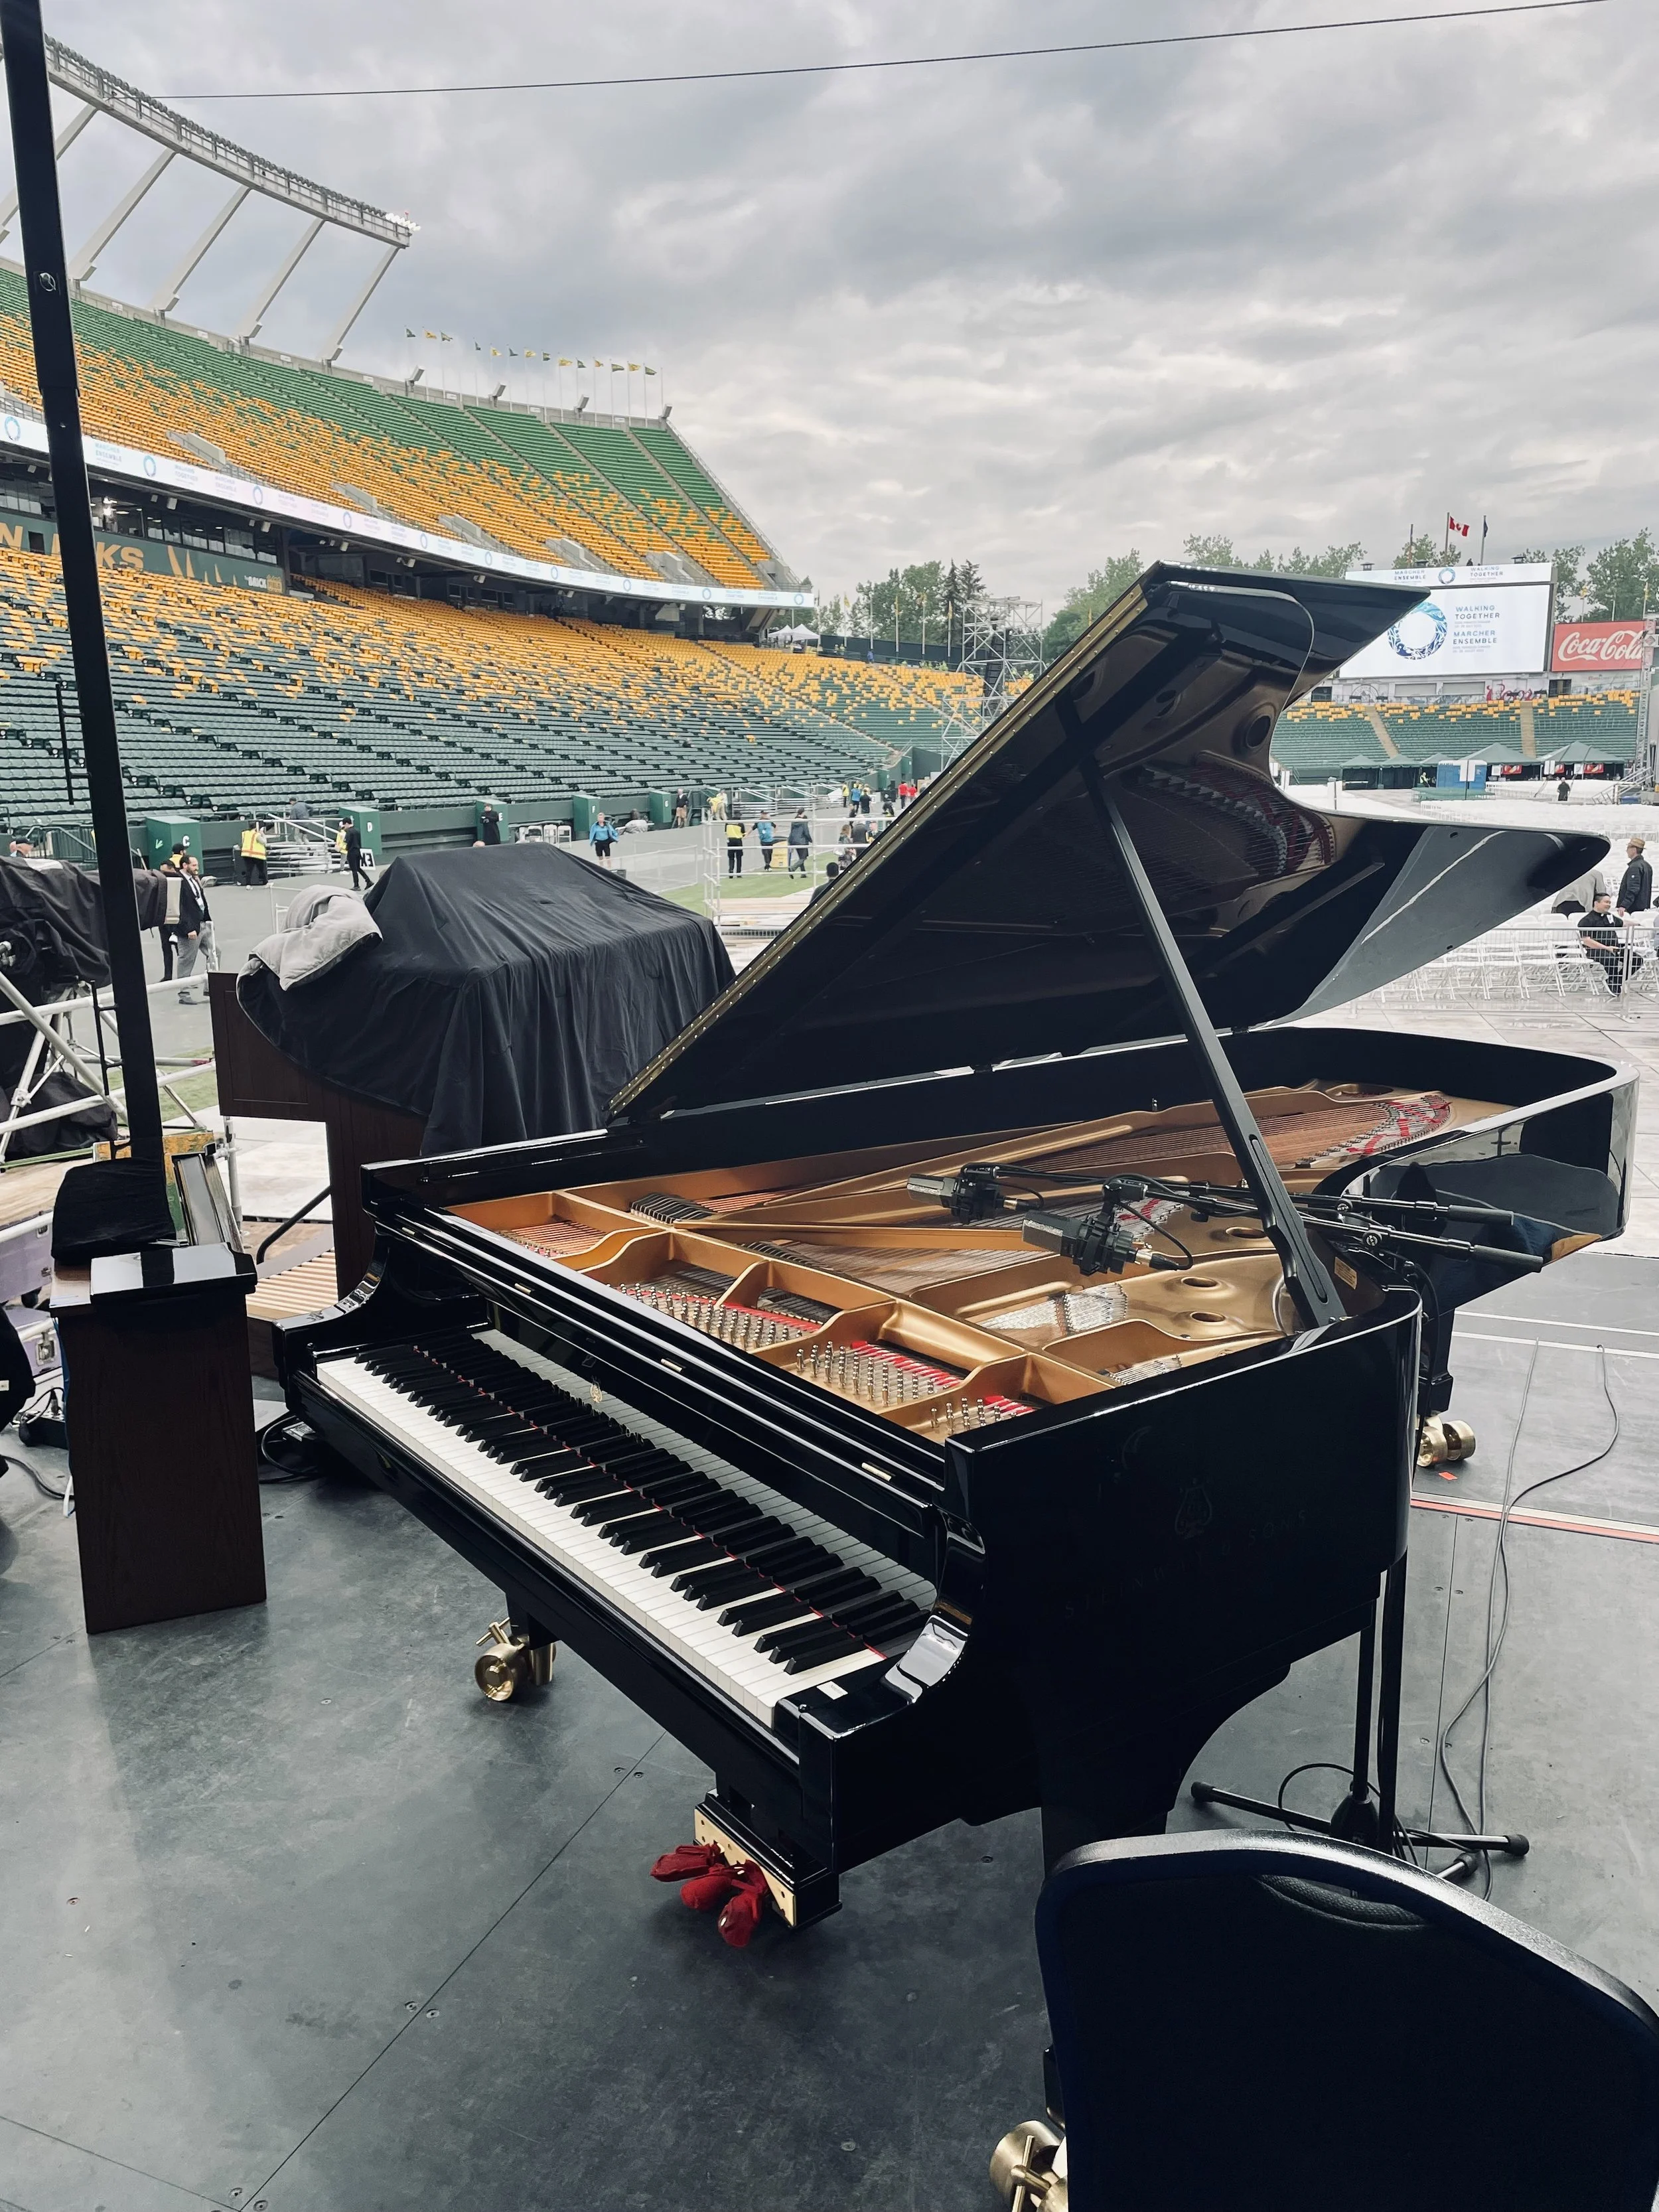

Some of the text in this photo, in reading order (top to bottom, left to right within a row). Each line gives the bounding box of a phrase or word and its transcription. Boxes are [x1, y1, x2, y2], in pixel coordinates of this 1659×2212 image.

[1558, 630, 1644, 662] Coca-Cola
[367, 822, 373, 832] D
[182, 835, 190, 847] C
